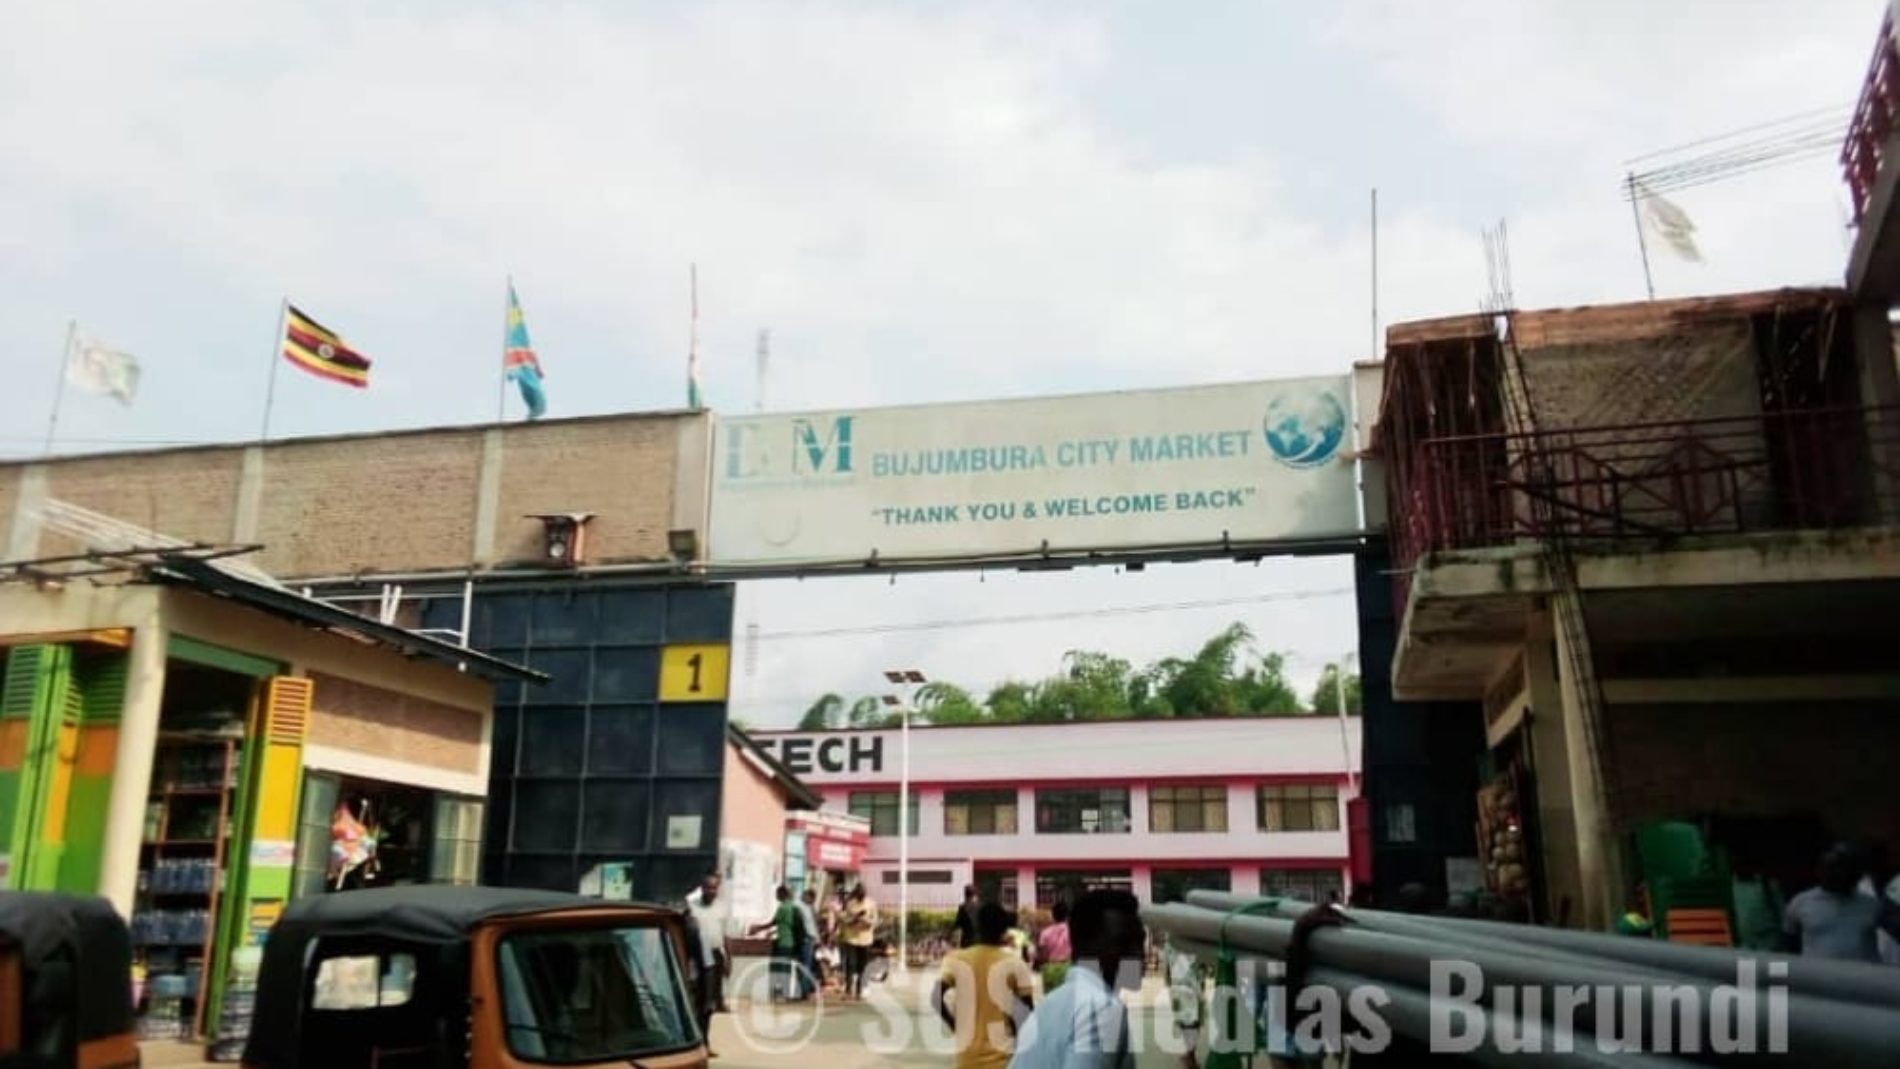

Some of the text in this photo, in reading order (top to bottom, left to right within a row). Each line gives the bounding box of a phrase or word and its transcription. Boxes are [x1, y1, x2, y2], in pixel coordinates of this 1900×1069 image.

[872, 430, 1251, 477] BUJUMBURA CITY MARKET
[967, 503, 1015, 520] YOU
[1023, 502, 1036, 518] &
[1045, 495, 1167, 517] WELCOME
[687, 652, 703, 693] 1
